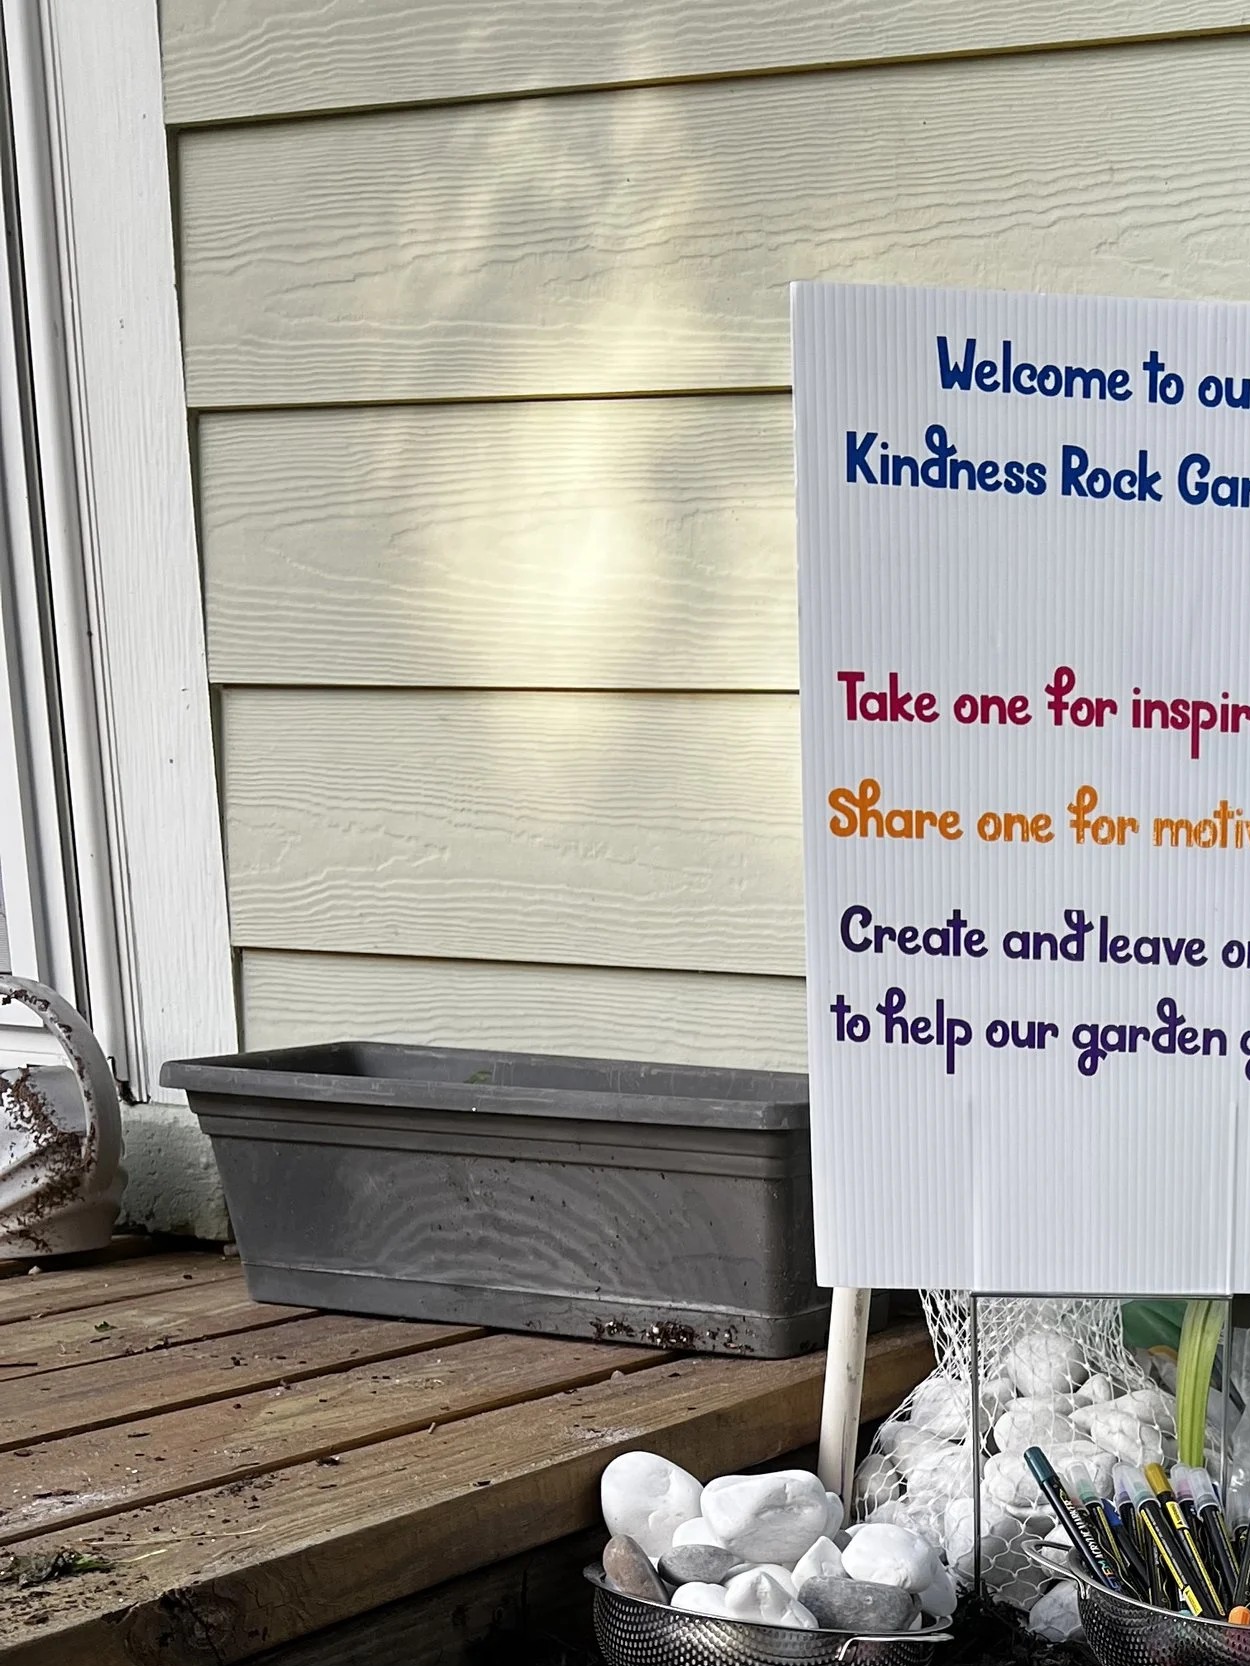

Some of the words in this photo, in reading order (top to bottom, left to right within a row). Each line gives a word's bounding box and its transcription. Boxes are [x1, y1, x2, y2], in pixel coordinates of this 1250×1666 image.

[937, 337, 1132, 401] Welcome
[1143, 351, 1184, 404] to
[847, 425, 1046, 495] Kindness
[1062, 445, 1162, 501] Rock
[838, 672, 939, 722] Take
[954, 695, 1031, 725] one
[1045, 667, 1117, 727] for
[828, 779, 963, 840] Share
[977, 812, 1054, 843] one
[1068, 785, 1138, 845] for
[841, 906, 987, 956] Create
[1003, 910, 1093, 960] and
[1099, 916, 1206, 966] leave
[831, 995, 870, 1041] to
[877, 988, 972, 1073] help
[987, 1021, 1058, 1048] our
[1073, 998, 1226, 1075] garden
